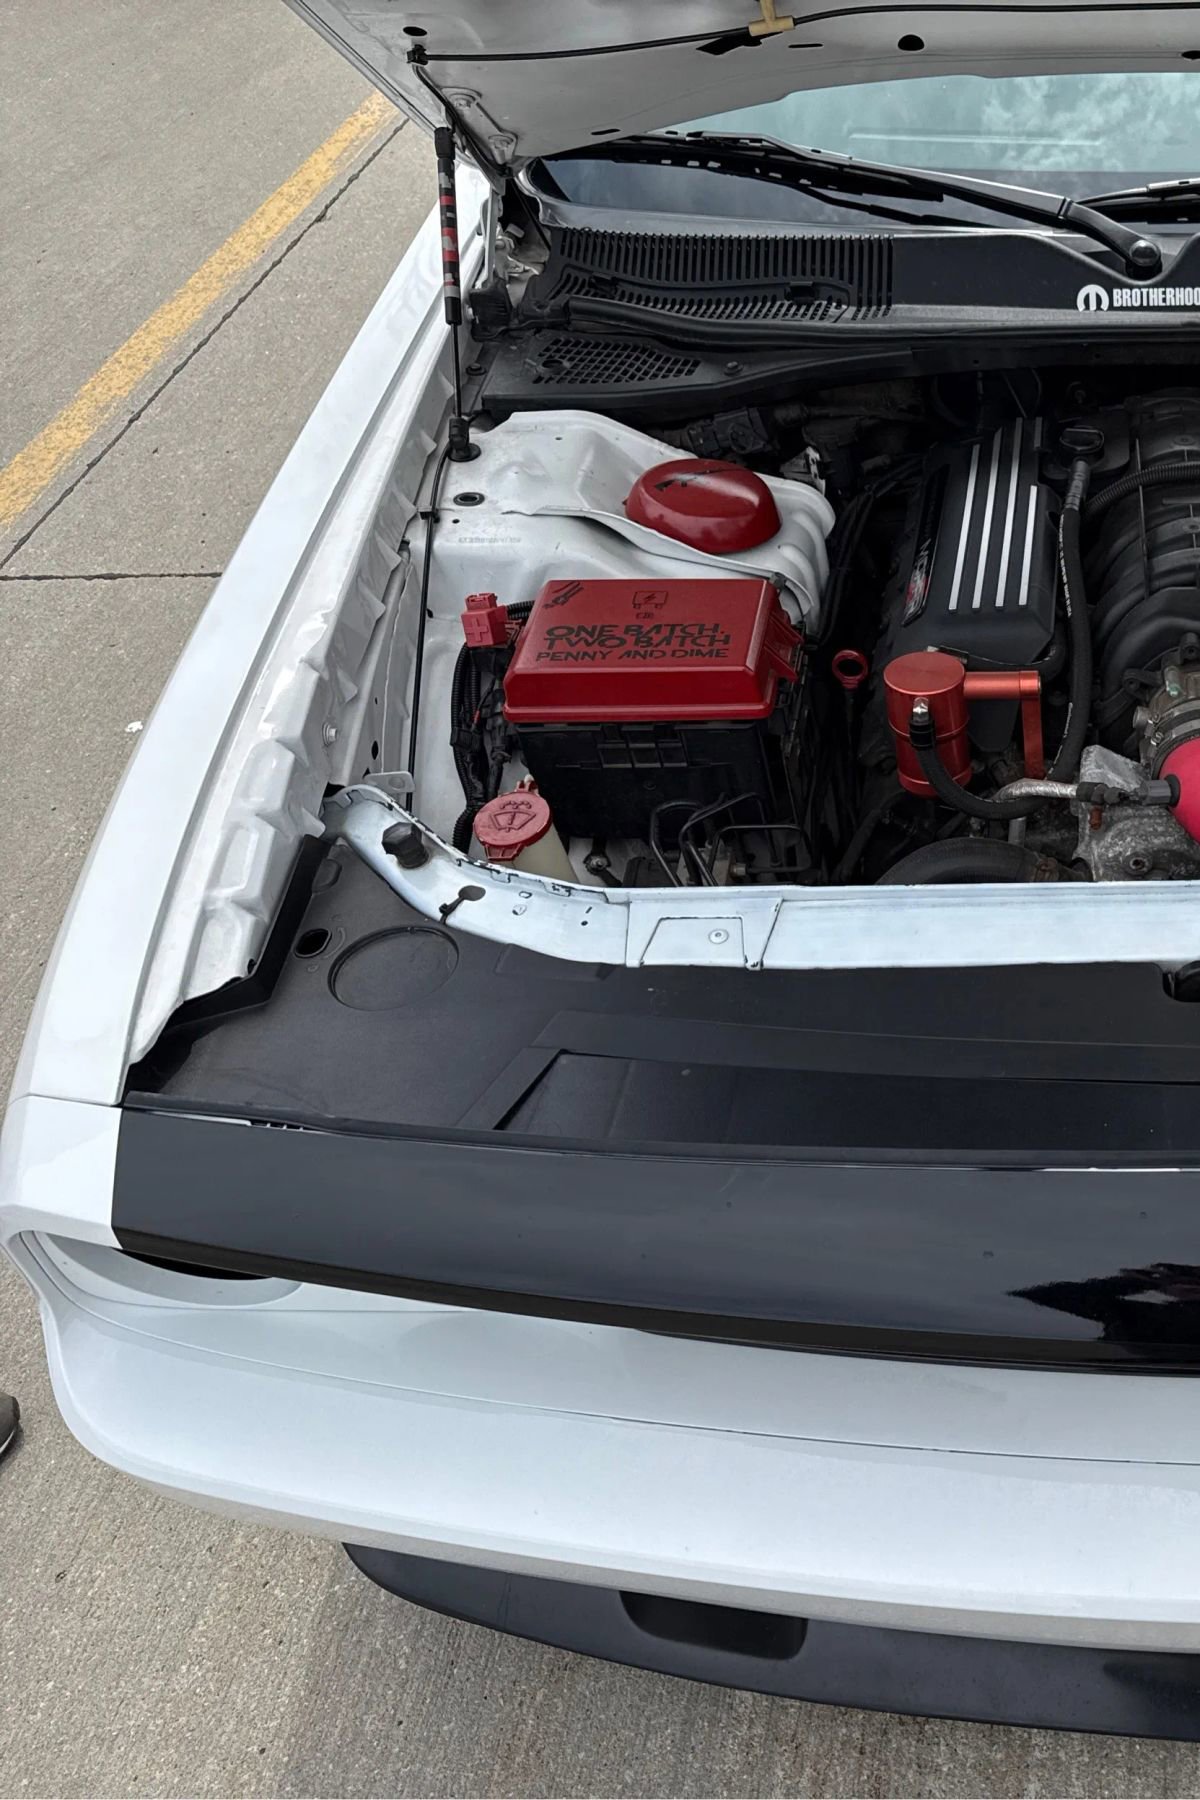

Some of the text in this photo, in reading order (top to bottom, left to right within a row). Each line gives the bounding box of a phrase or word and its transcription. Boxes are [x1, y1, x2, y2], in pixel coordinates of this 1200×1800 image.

[546, 624, 619, 638] ONE
[544, 634, 731, 650] TWO BATCH
[536, 648, 729, 662] PENNY AND DIME
